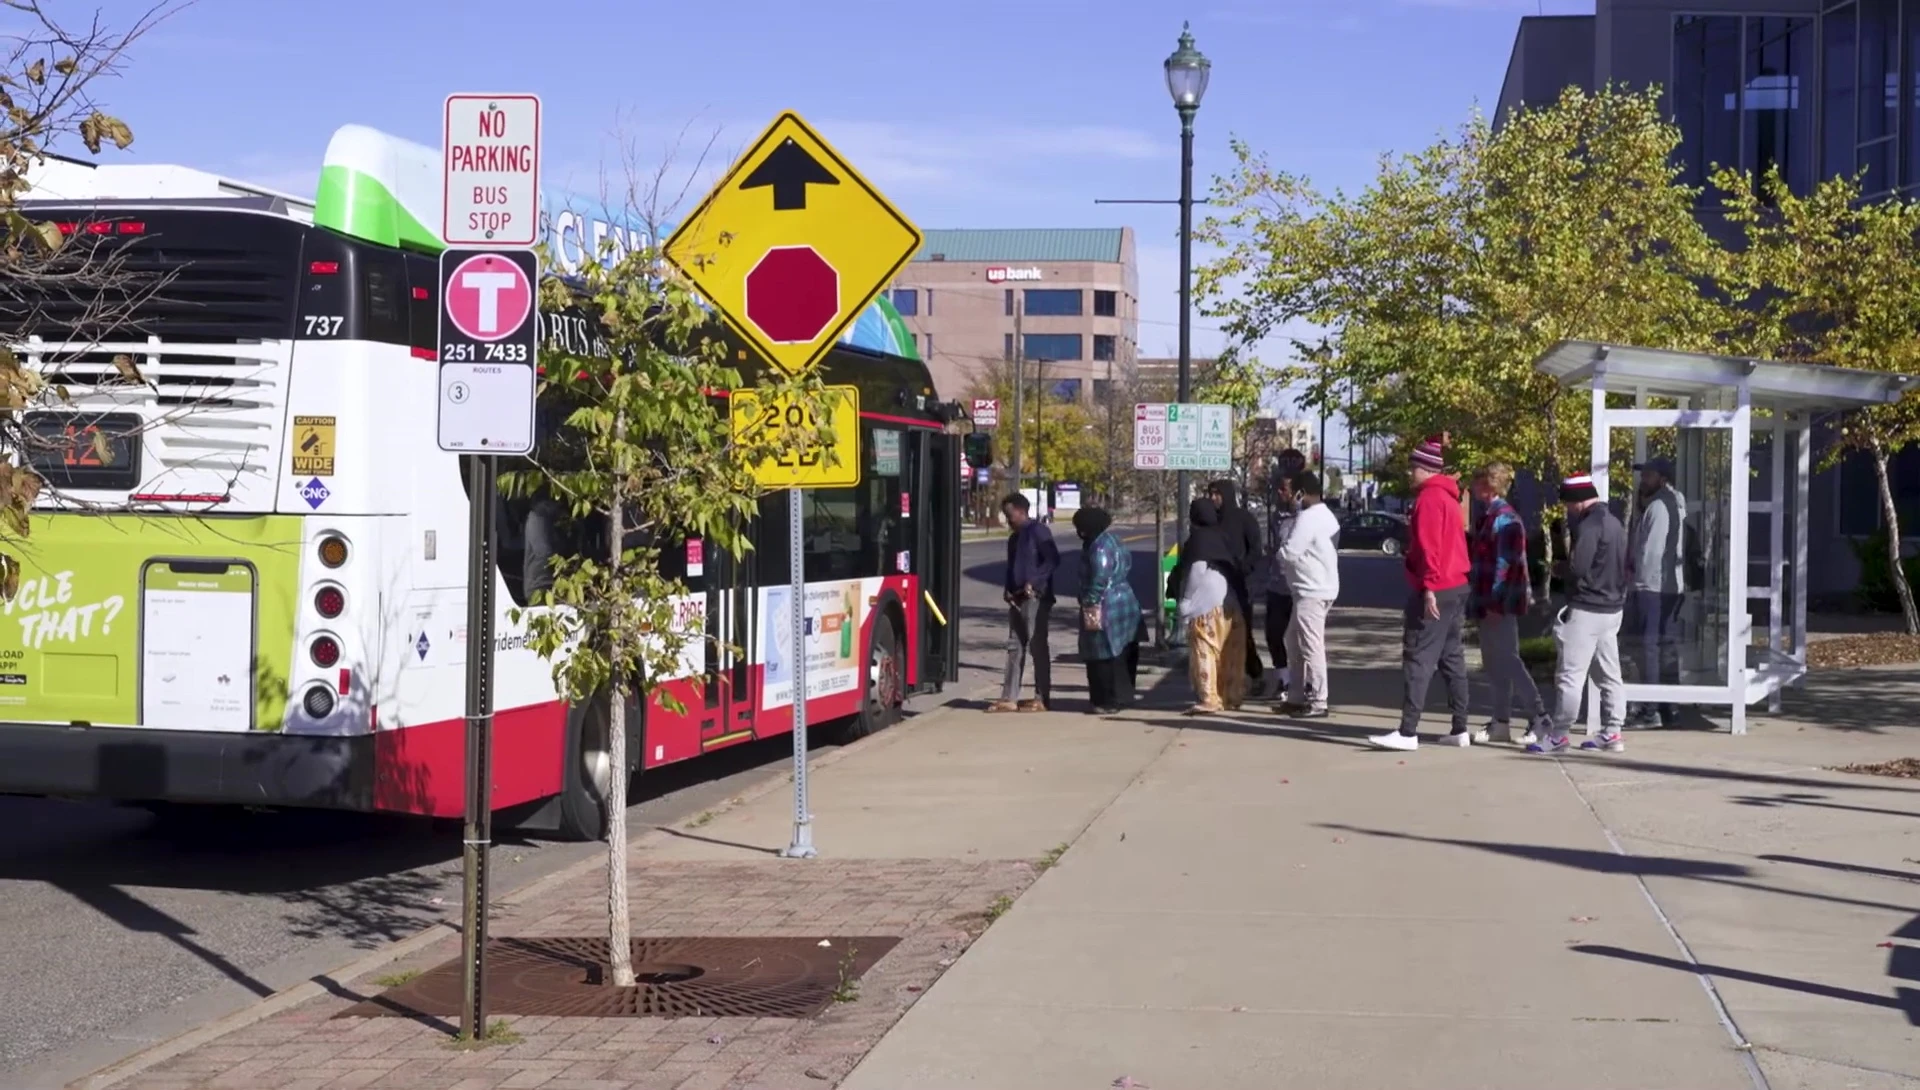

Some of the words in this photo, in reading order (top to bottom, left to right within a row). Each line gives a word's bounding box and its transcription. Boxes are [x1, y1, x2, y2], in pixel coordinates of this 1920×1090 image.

[479, 110, 505, 138] NO
[452, 145, 531, 173] PARKING
[473, 186, 508, 205] BUS
[468, 212, 512, 230] STOP
[462, 272, 516, 332] T
[304, 315, 345, 336] 737
[550, 312, 589, 357] BUS
[444, 343, 475, 361] 251
[484, 343, 528, 361] 7433
[472, 366, 502, 375] ROUTES
[454, 385, 464, 400] 3
[974, 399, 996, 409] PX
[1170, 405, 1177, 420] 2
[296, 417, 334, 425] CAUTION
[1211, 419, 1219, 430] A
[1142, 425, 1161, 435] BUS
[1140, 436, 1163, 446] STOP
[294, 457, 333, 470] WIDE
[1142, 456, 1160, 465] END
[1169, 456, 1196, 466] BEGIN
[1201, 456, 1228, 466] BEGIN
[301, 486, 328, 500] CNG
[18, 595, 125, 649] THAT?
